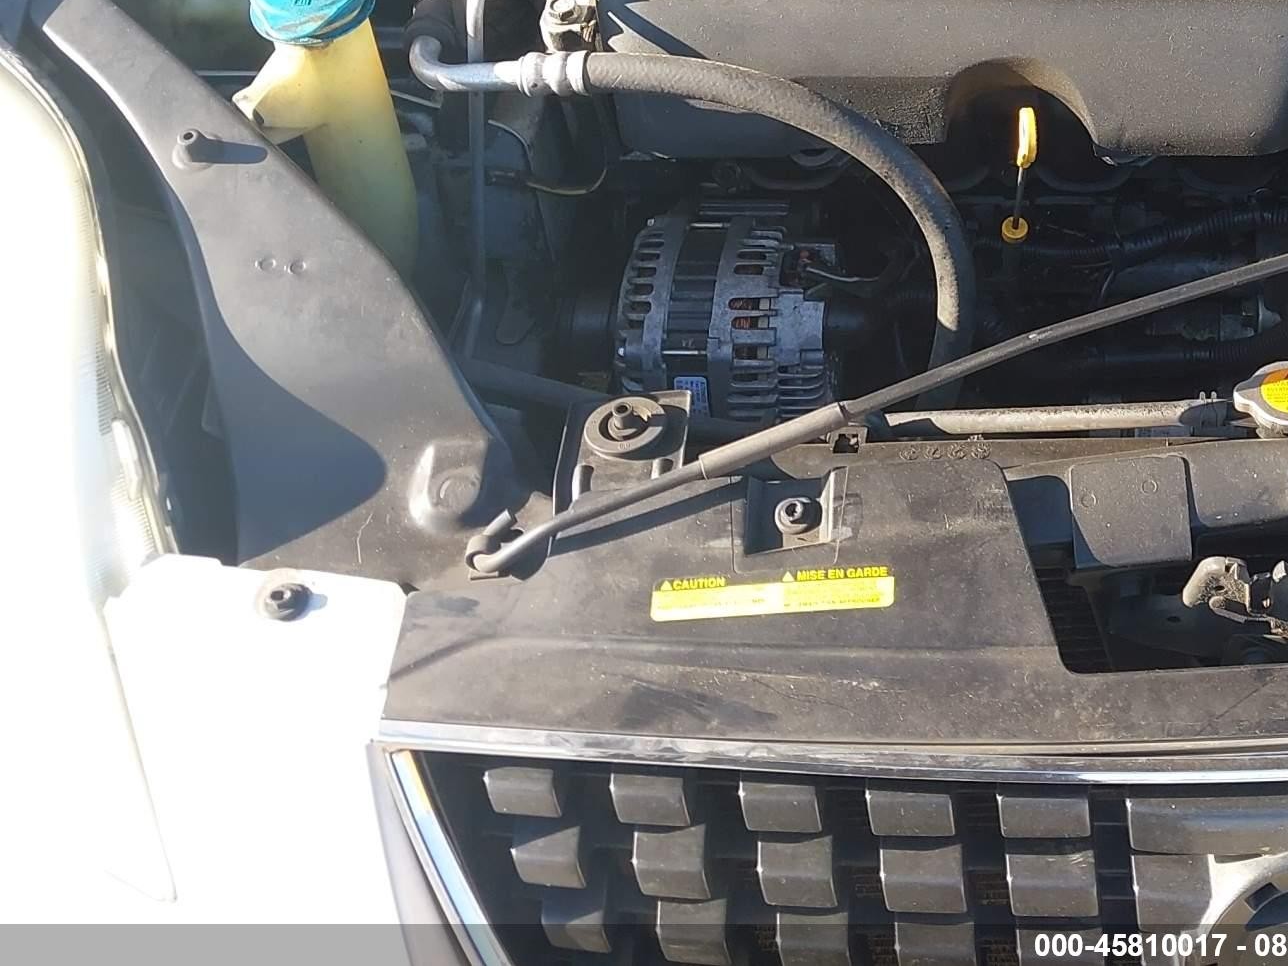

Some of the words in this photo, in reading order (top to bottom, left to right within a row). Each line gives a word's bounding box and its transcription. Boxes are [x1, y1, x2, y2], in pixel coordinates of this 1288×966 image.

[796, 570, 826, 581] MISE
[828, 568, 845, 579] EN
[847, 566, 888, 579] GARDE
[673, 577, 725, 590] CAUTION
